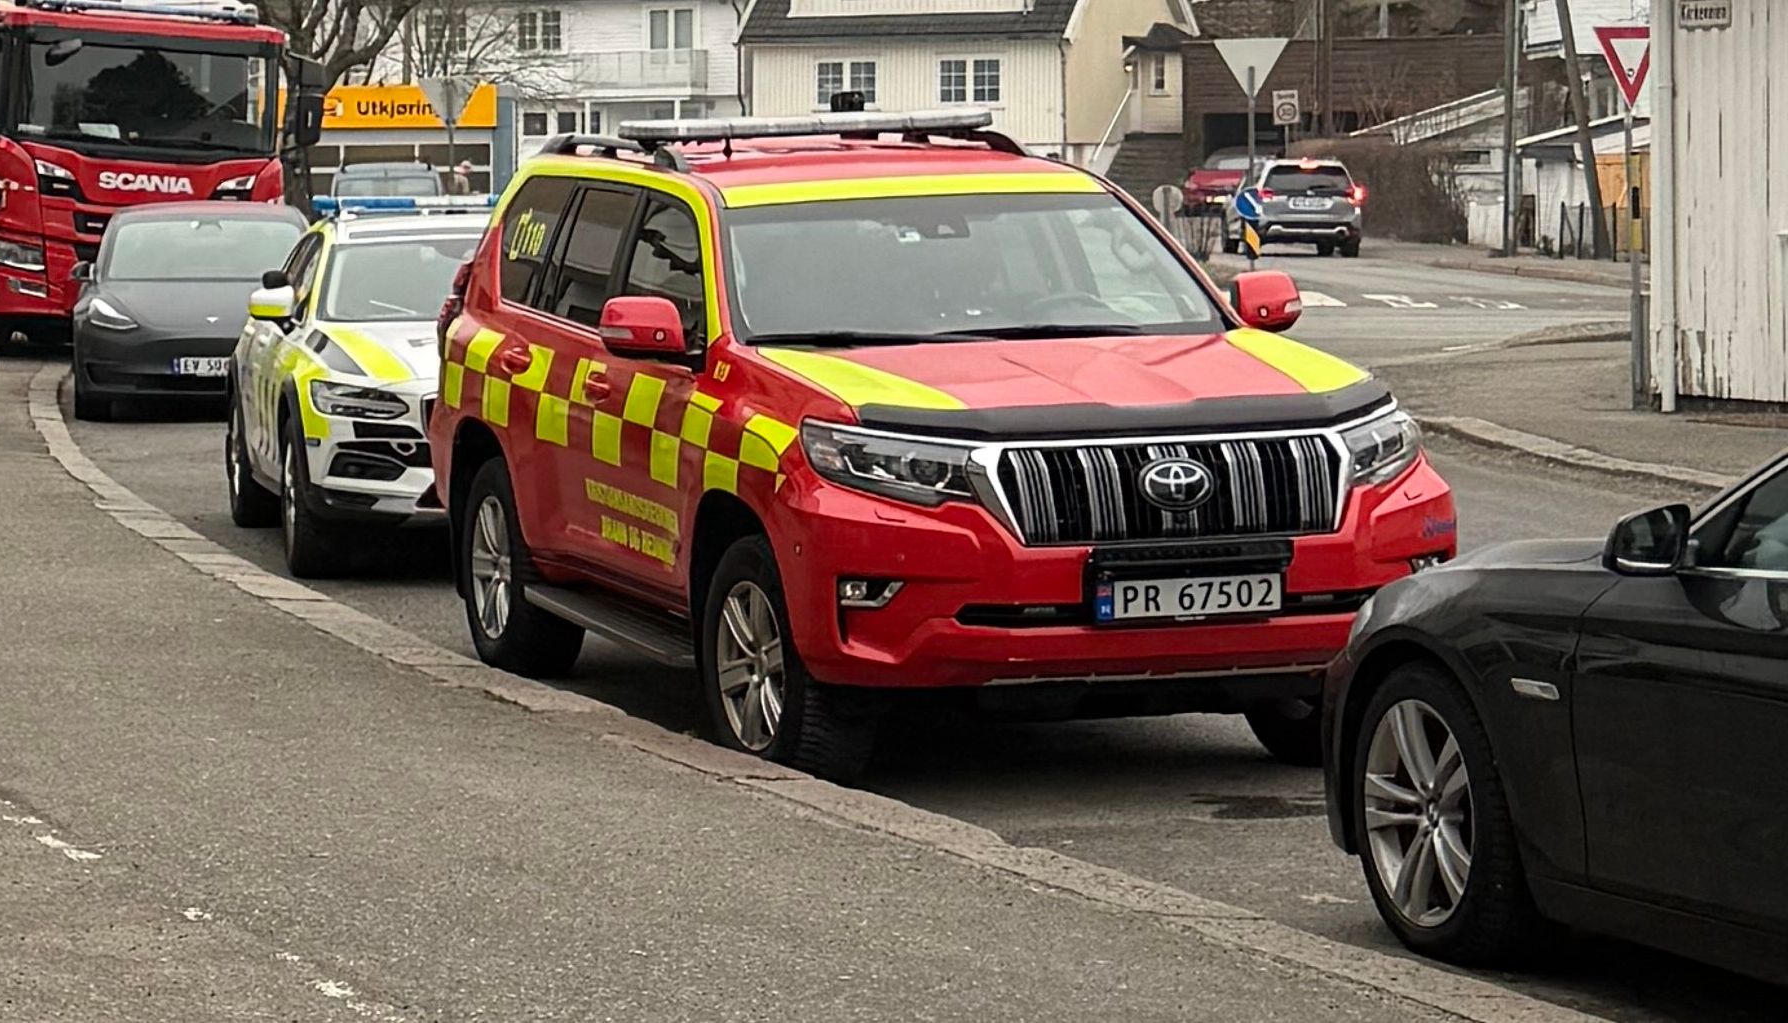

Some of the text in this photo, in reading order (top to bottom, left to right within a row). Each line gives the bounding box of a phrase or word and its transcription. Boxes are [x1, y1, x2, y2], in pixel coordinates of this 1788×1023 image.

[357, 100, 440, 118] Utkjørin
[98, 171, 194, 195] SCANIA
[1122, 585, 1161, 614] PR
[1178, 578, 1274, 611] 67502
